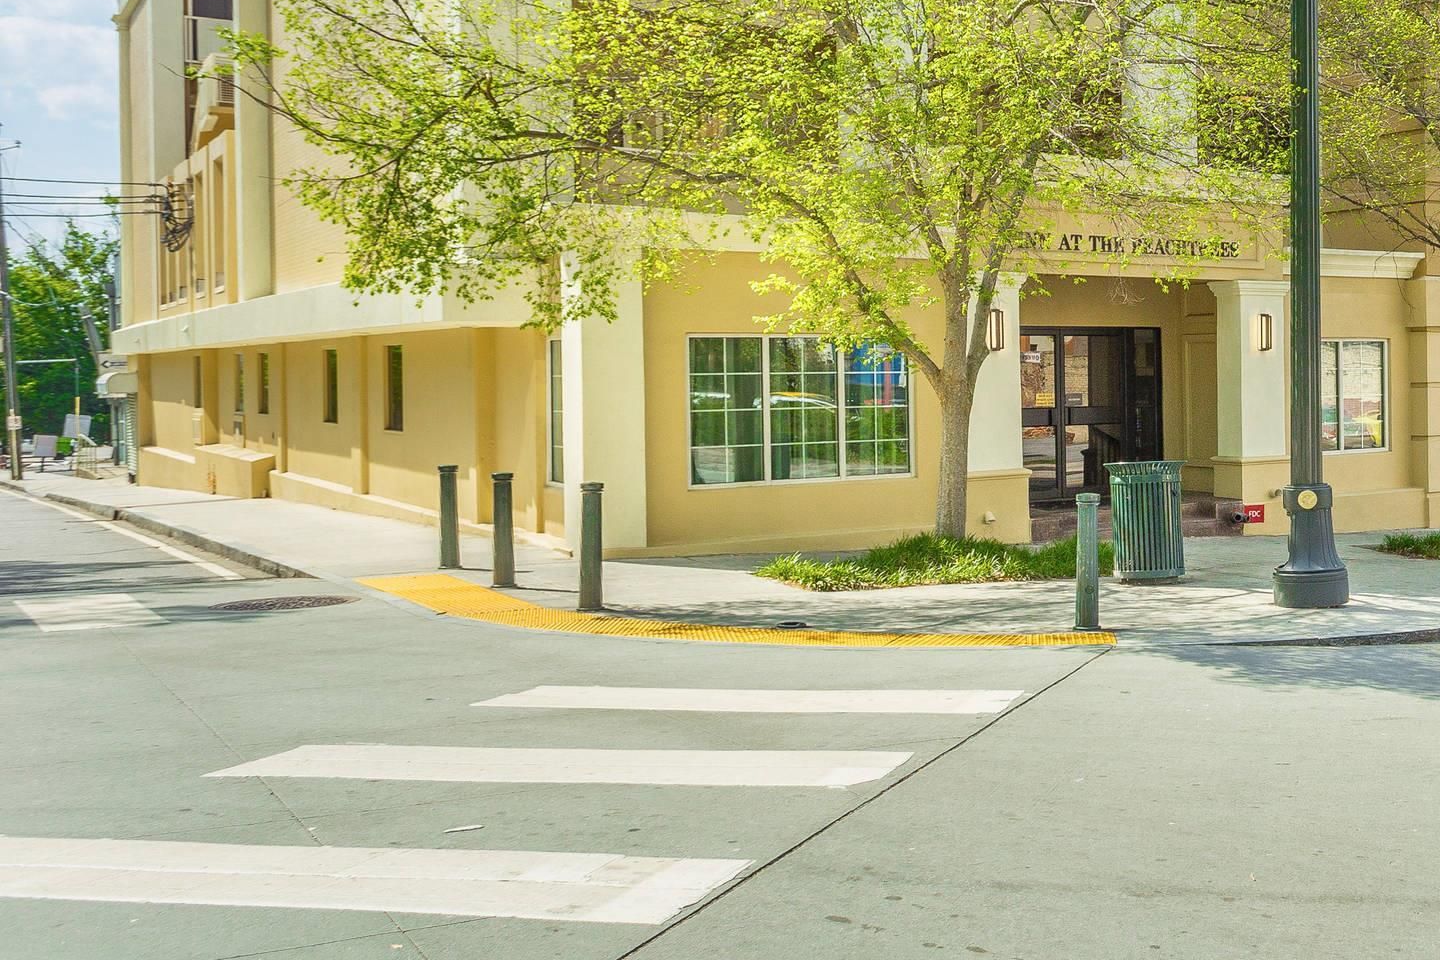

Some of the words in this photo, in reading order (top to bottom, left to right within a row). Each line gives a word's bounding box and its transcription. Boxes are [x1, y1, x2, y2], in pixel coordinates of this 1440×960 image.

[1058, 233, 1083, 251] AT
[1088, 235, 1125, 253] THE
[1248, 510, 1261, 518] FDC
